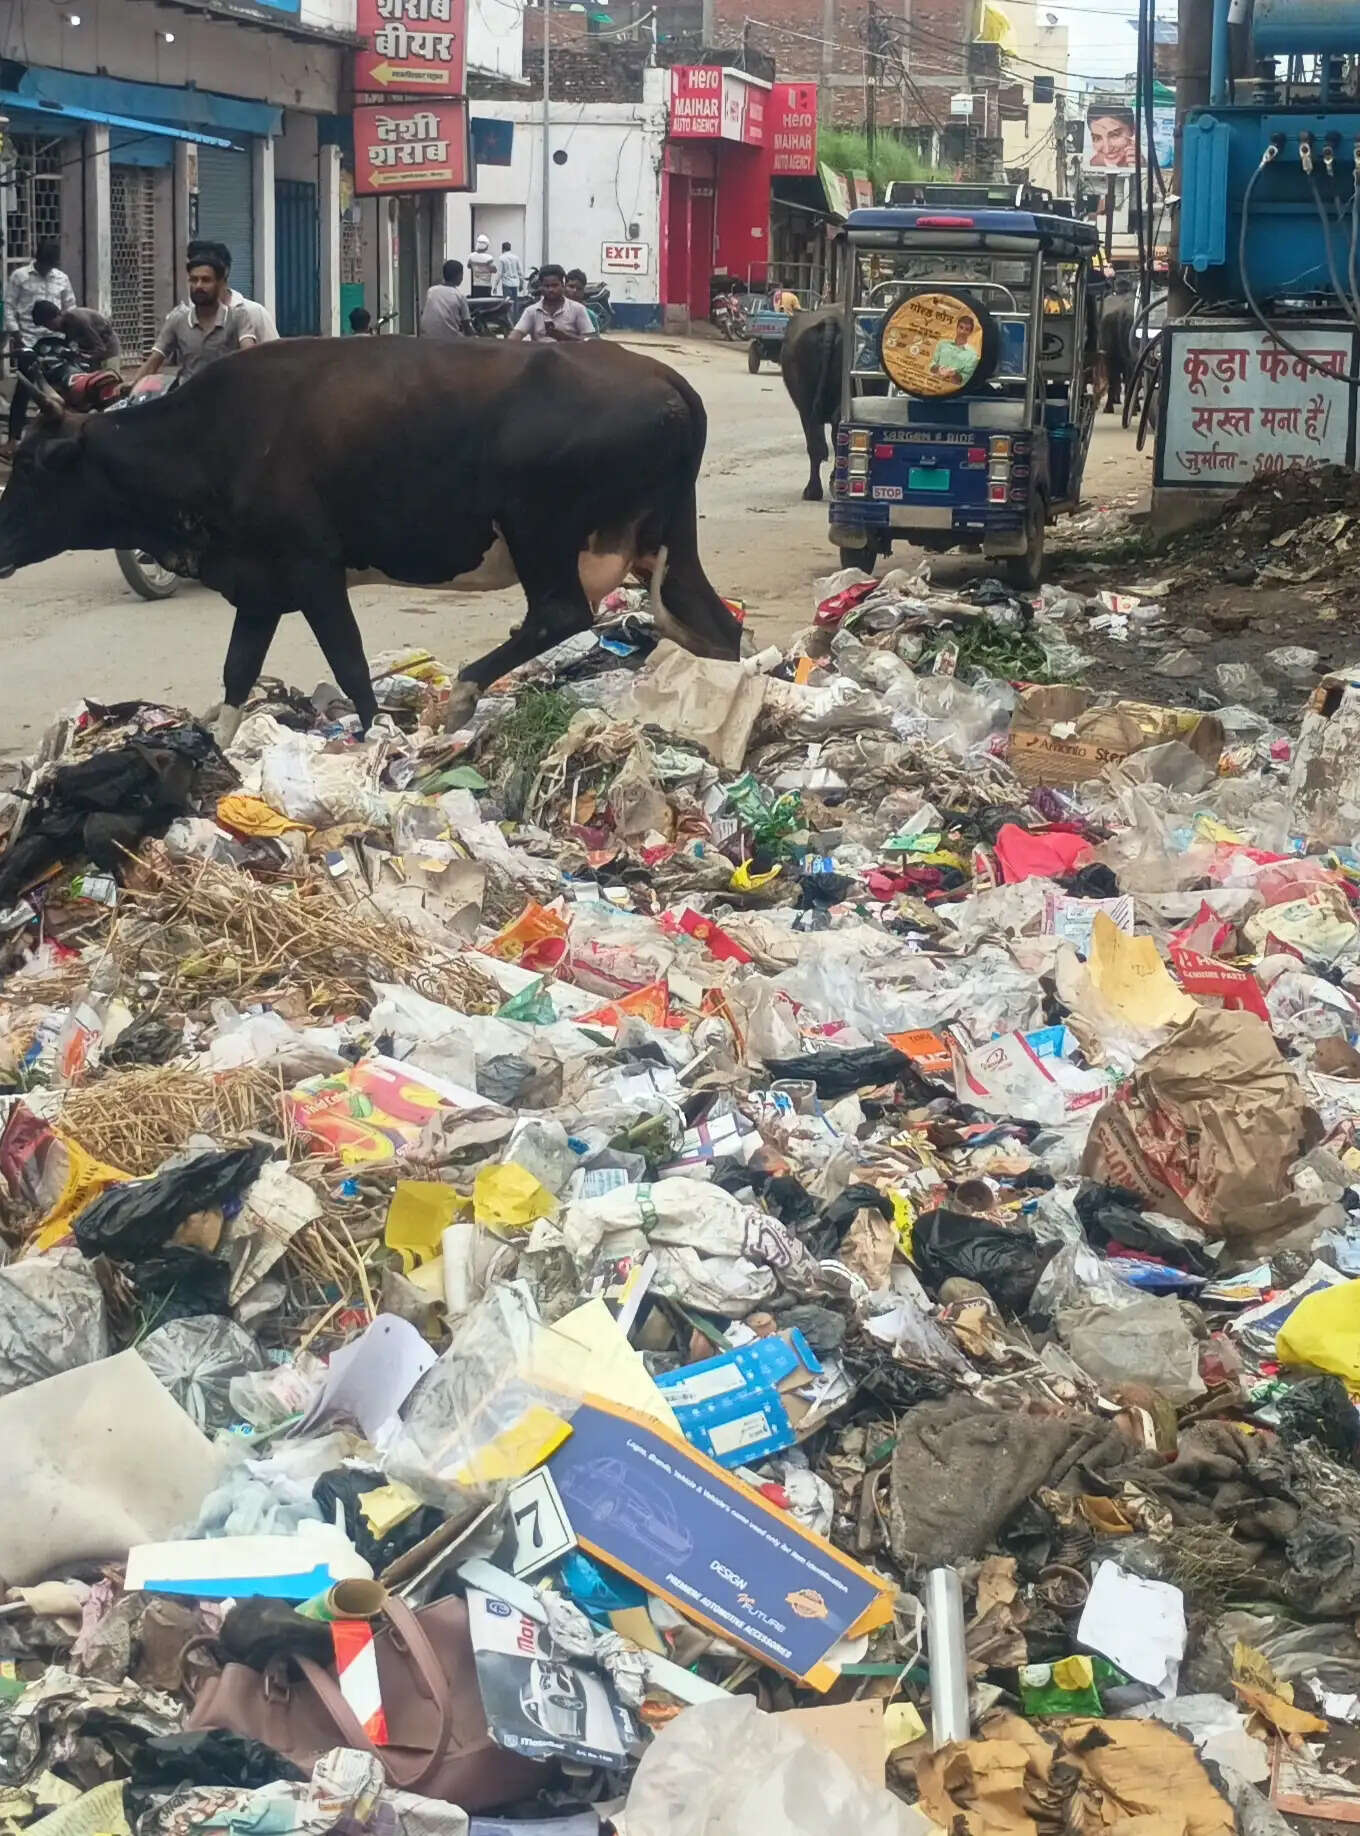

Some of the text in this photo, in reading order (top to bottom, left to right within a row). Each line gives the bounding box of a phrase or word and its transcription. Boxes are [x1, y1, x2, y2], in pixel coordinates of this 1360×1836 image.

[374, 22, 456, 61] बीयर
[688, 70, 719, 89] Hero
[675, 98, 719, 117] MAIHAR
[376, 112, 440, 141] देशी
[673, 117, 720, 133] AUTO AGENCY
[783, 114, 812, 128] Hero
[774, 134, 812, 150] MAIHAR
[368, 140, 451, 167] शराब
[790, 154, 811, 170] AGENCY
[605, 246, 643, 260] EXIT
[1183, 348, 1250, 396] कूड़ा
[1191, 406, 1255, 438] सख्त
[1259, 407, 1303, 437] मना
[1175, 440, 1238, 476] जुर्माना
[1252, 452, 1283, 473] 500
[874, 486, 903, 499] STOP
[763, 1533, 781, 1548] only
[708, 1558, 749, 1591] DESIGN
[741, 1599, 787, 1635] FUTURE
